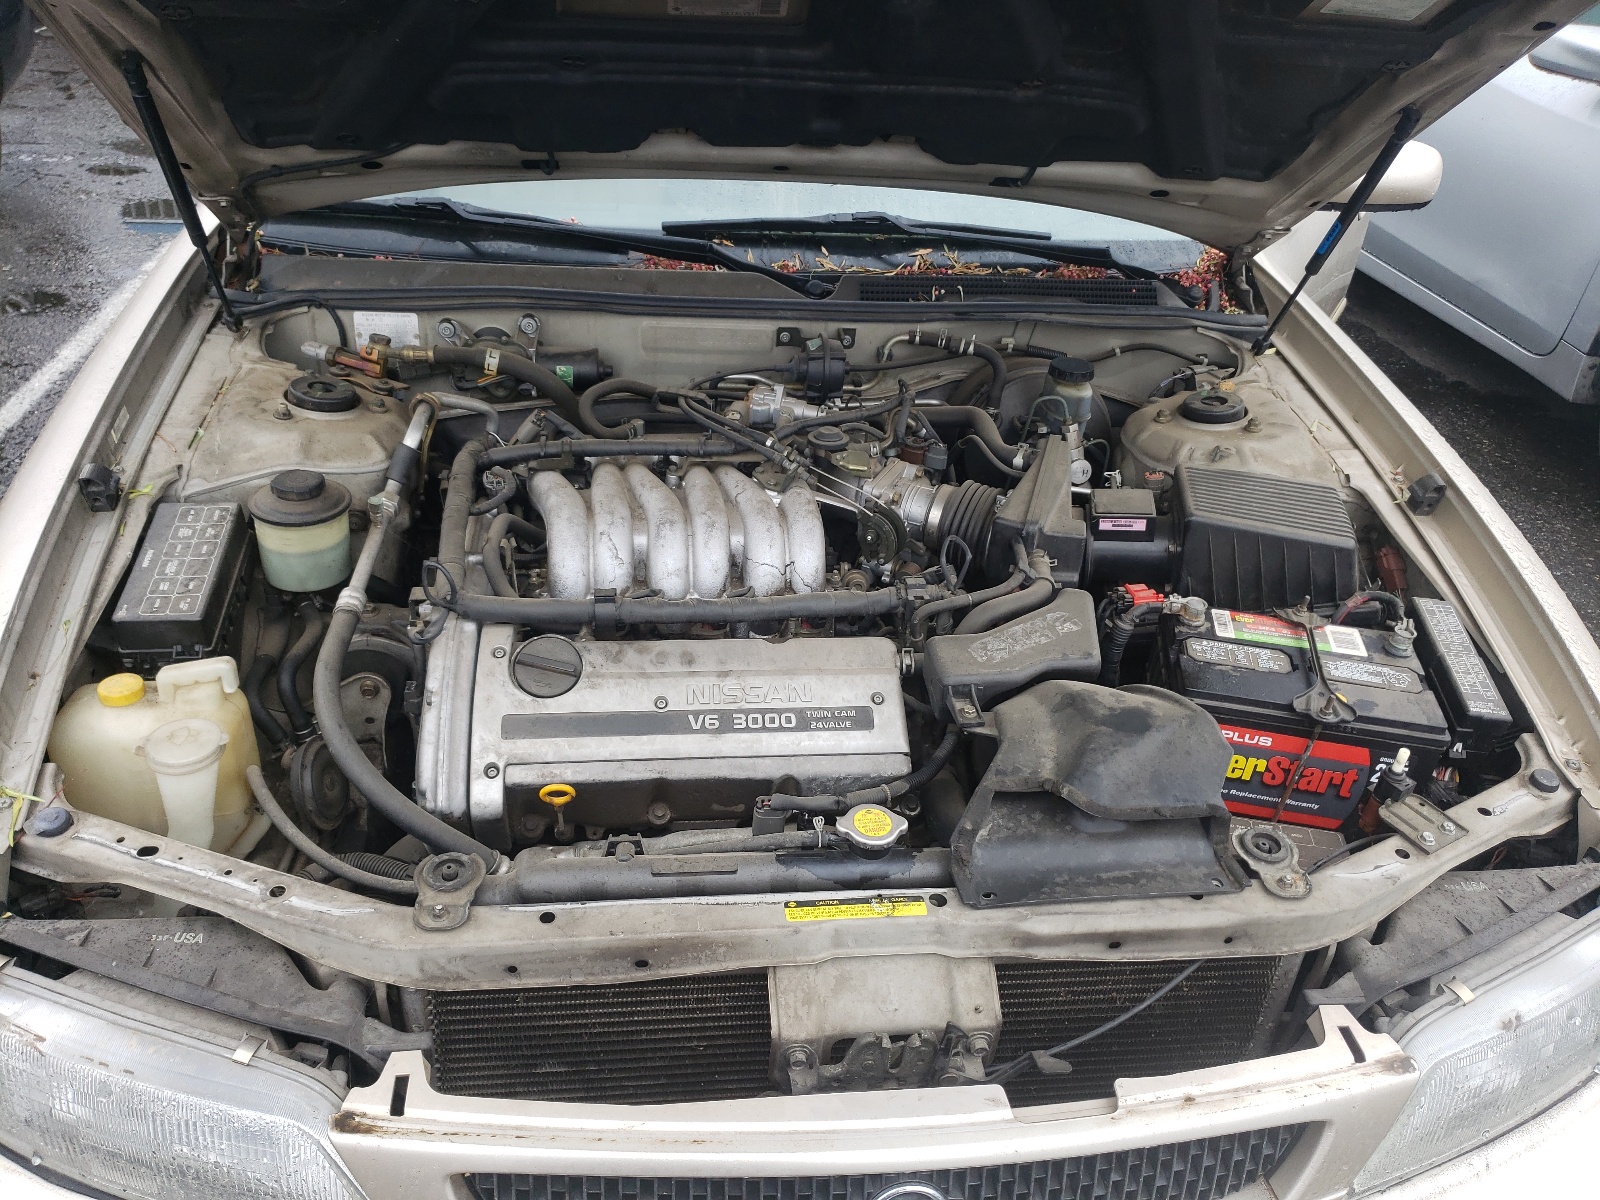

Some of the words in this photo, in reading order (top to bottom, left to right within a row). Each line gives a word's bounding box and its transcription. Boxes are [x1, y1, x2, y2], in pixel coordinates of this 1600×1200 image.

[686, 681, 813, 705] NISSAN
[688, 714, 720, 730] V6
[732, 713, 797, 729] 3000
[805, 710, 831, 718] TWIN
[834, 710, 857, 718] CAM
[810, 721, 852, 729] 24VALVE
[1221, 729, 1273, 747] PLUS
[1225, 754, 1359, 798] erStart
[1229, 789, 1282, 803] Replacement
[1285, 798, 1320, 810] Warranty
[174, 932, 203, 943] USA
